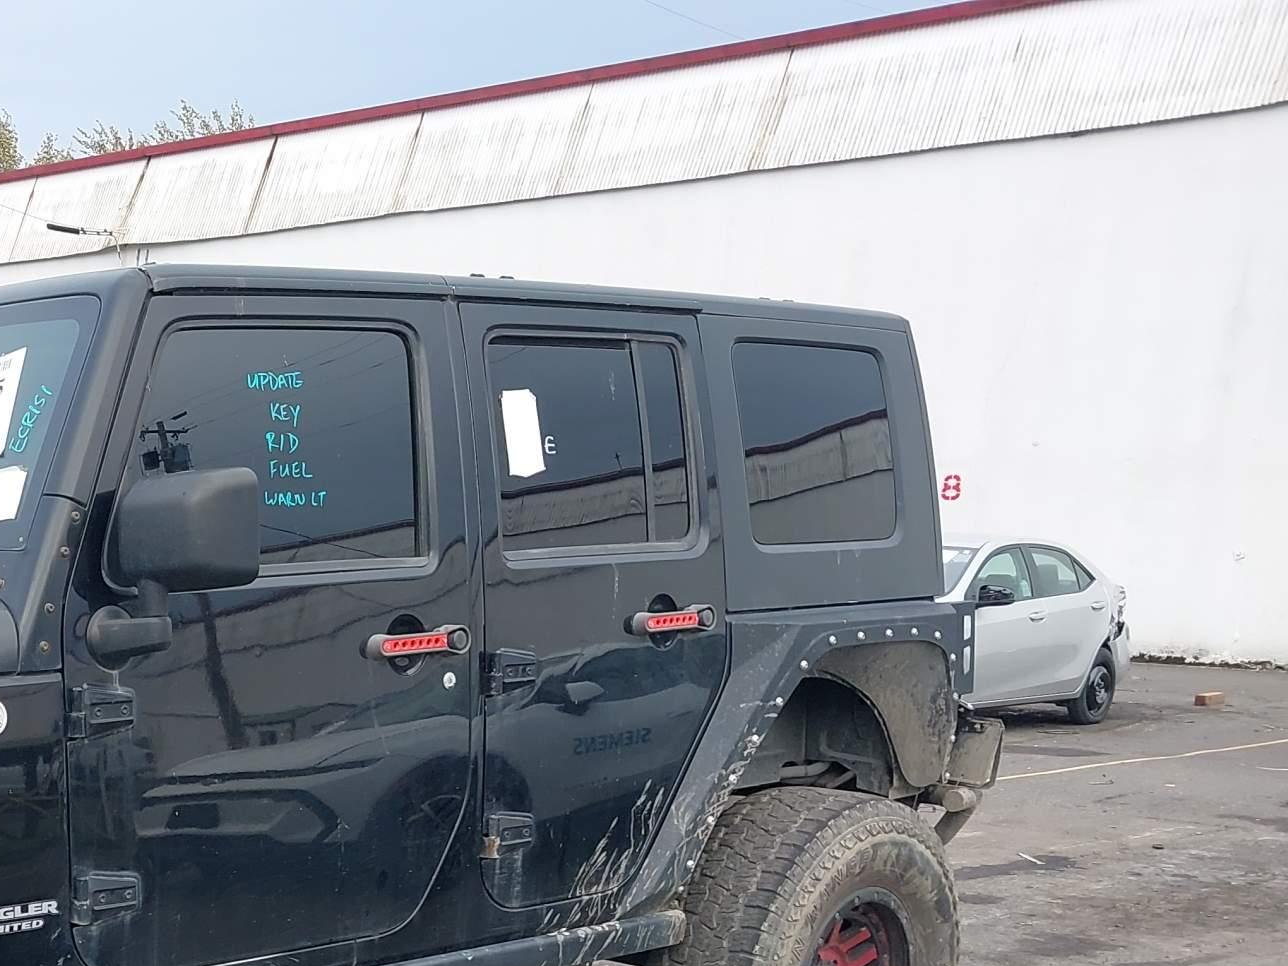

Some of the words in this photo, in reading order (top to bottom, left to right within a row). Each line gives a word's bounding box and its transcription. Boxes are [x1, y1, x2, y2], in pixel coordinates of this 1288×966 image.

[247, 371, 304, 391] UPDATE
[269, 402, 300, 428] KEY
[269, 460, 313, 479] FUEL
[941, 474, 961, 501] 8
[264, 491, 306, 507] WARN
[311, 491, 327, 508] LT
